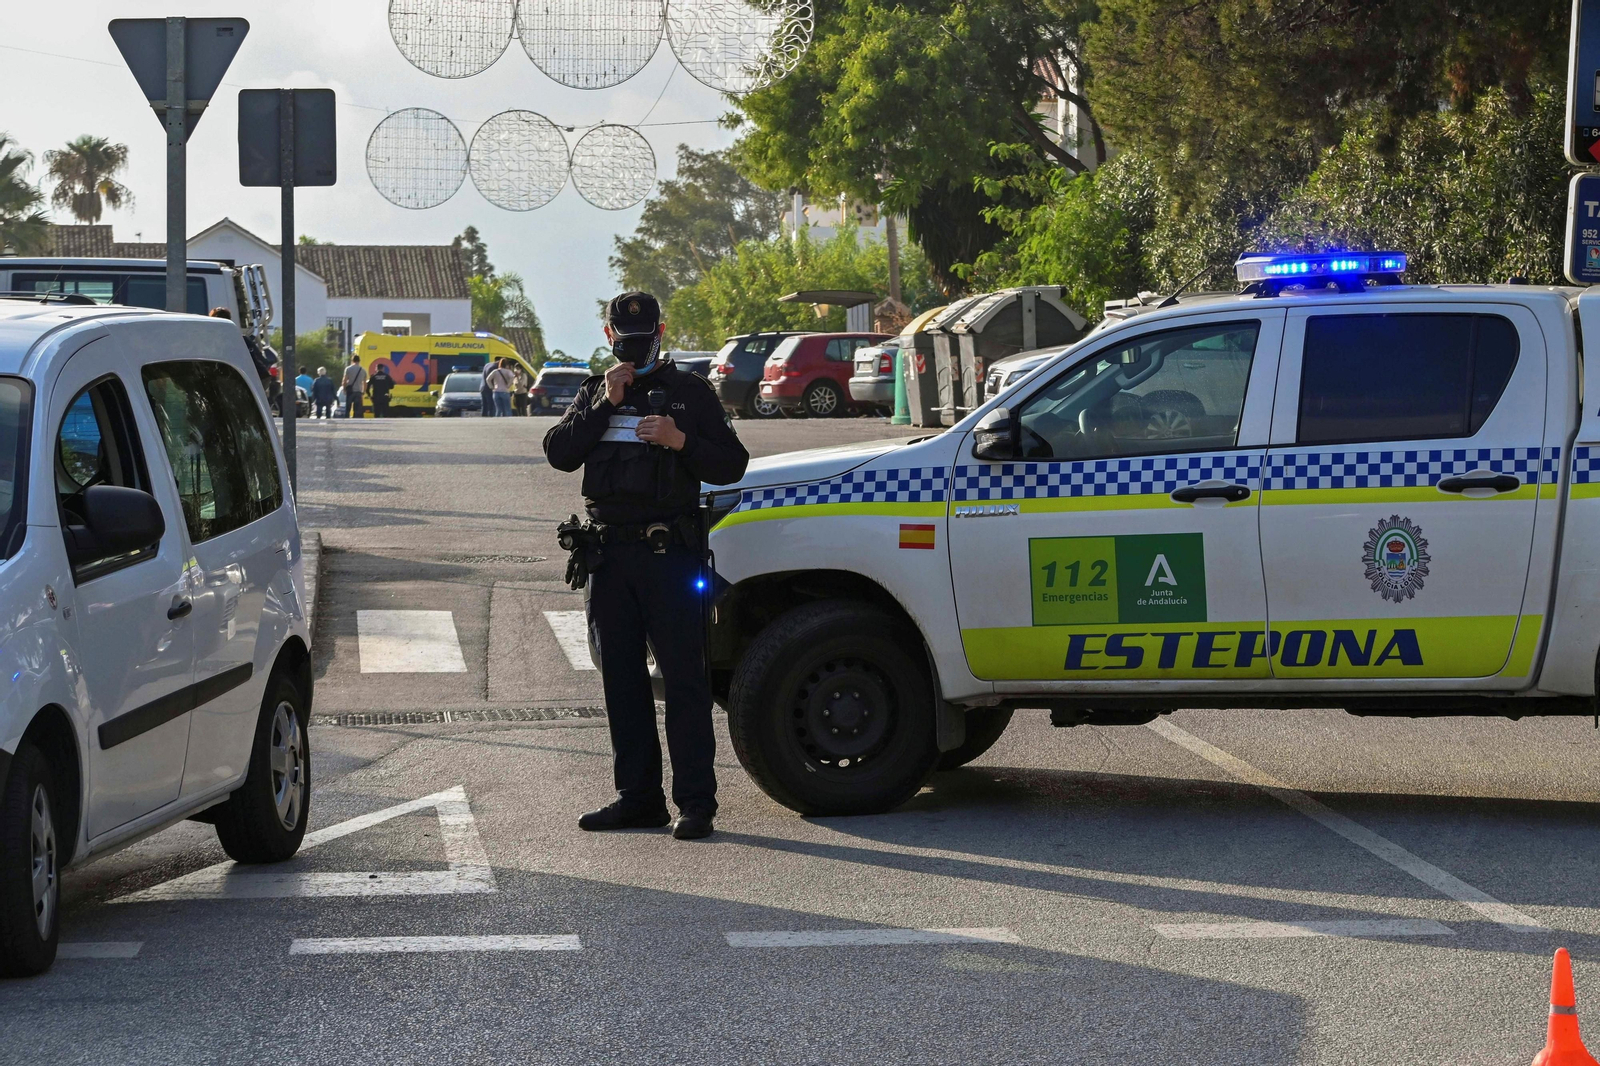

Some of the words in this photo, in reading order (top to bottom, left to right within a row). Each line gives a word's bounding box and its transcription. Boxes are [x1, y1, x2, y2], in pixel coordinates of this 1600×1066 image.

[1592, 128, 1600, 137] 6
[1584, 200, 1600, 218] T
[1582, 229, 1598, 239] 952
[434, 341, 486, 350] AMBULANCIA
[671, 402, 686, 411] CIA
[955, 503, 1019, 518] HILUX
[1041, 559, 1109, 588] 112
[1376, 566, 1399, 590] POLICIA
[1400, 567, 1418, 589] LOCAL
[1042, 591, 1109, 604] Emergencias
[1150, 589, 1174, 597] Junta
[1137, 598, 1147, 606] de
[1148, 596, 1188, 606] Andalucía
[1063, 628, 1425, 671] ESTEPONA
